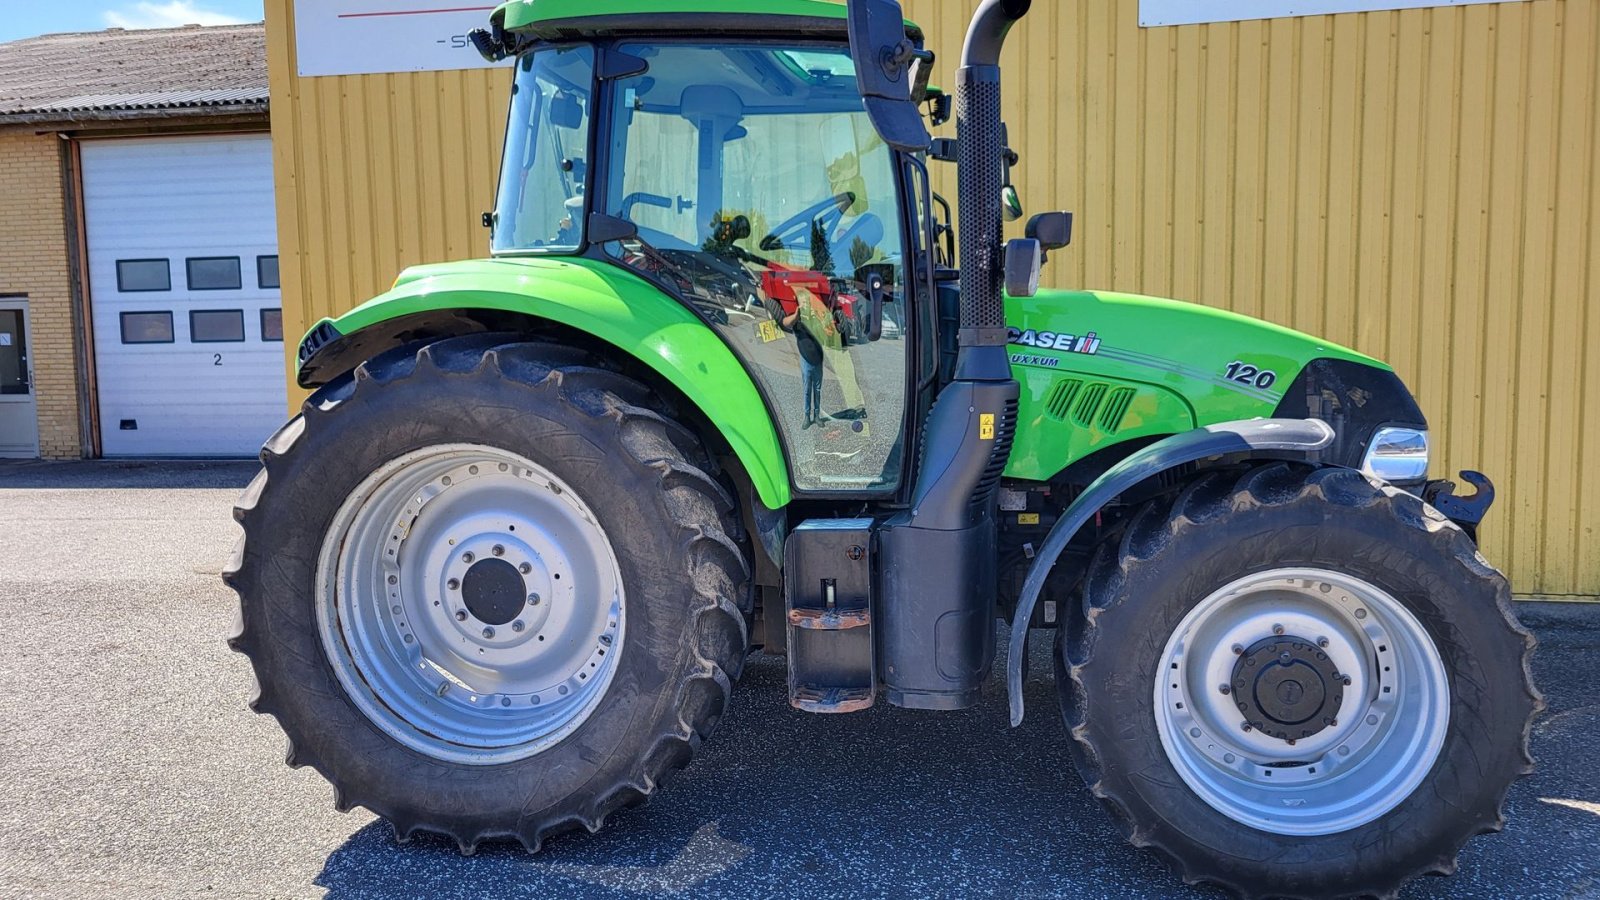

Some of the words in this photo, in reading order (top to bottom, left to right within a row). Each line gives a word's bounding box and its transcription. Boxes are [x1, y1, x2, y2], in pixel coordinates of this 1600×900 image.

[1007, 327, 1075, 351] CASE
[213, 353, 223, 366] 2
[1010, 354, 1059, 367] UXXUM
[1224, 361, 1276, 391] 120
